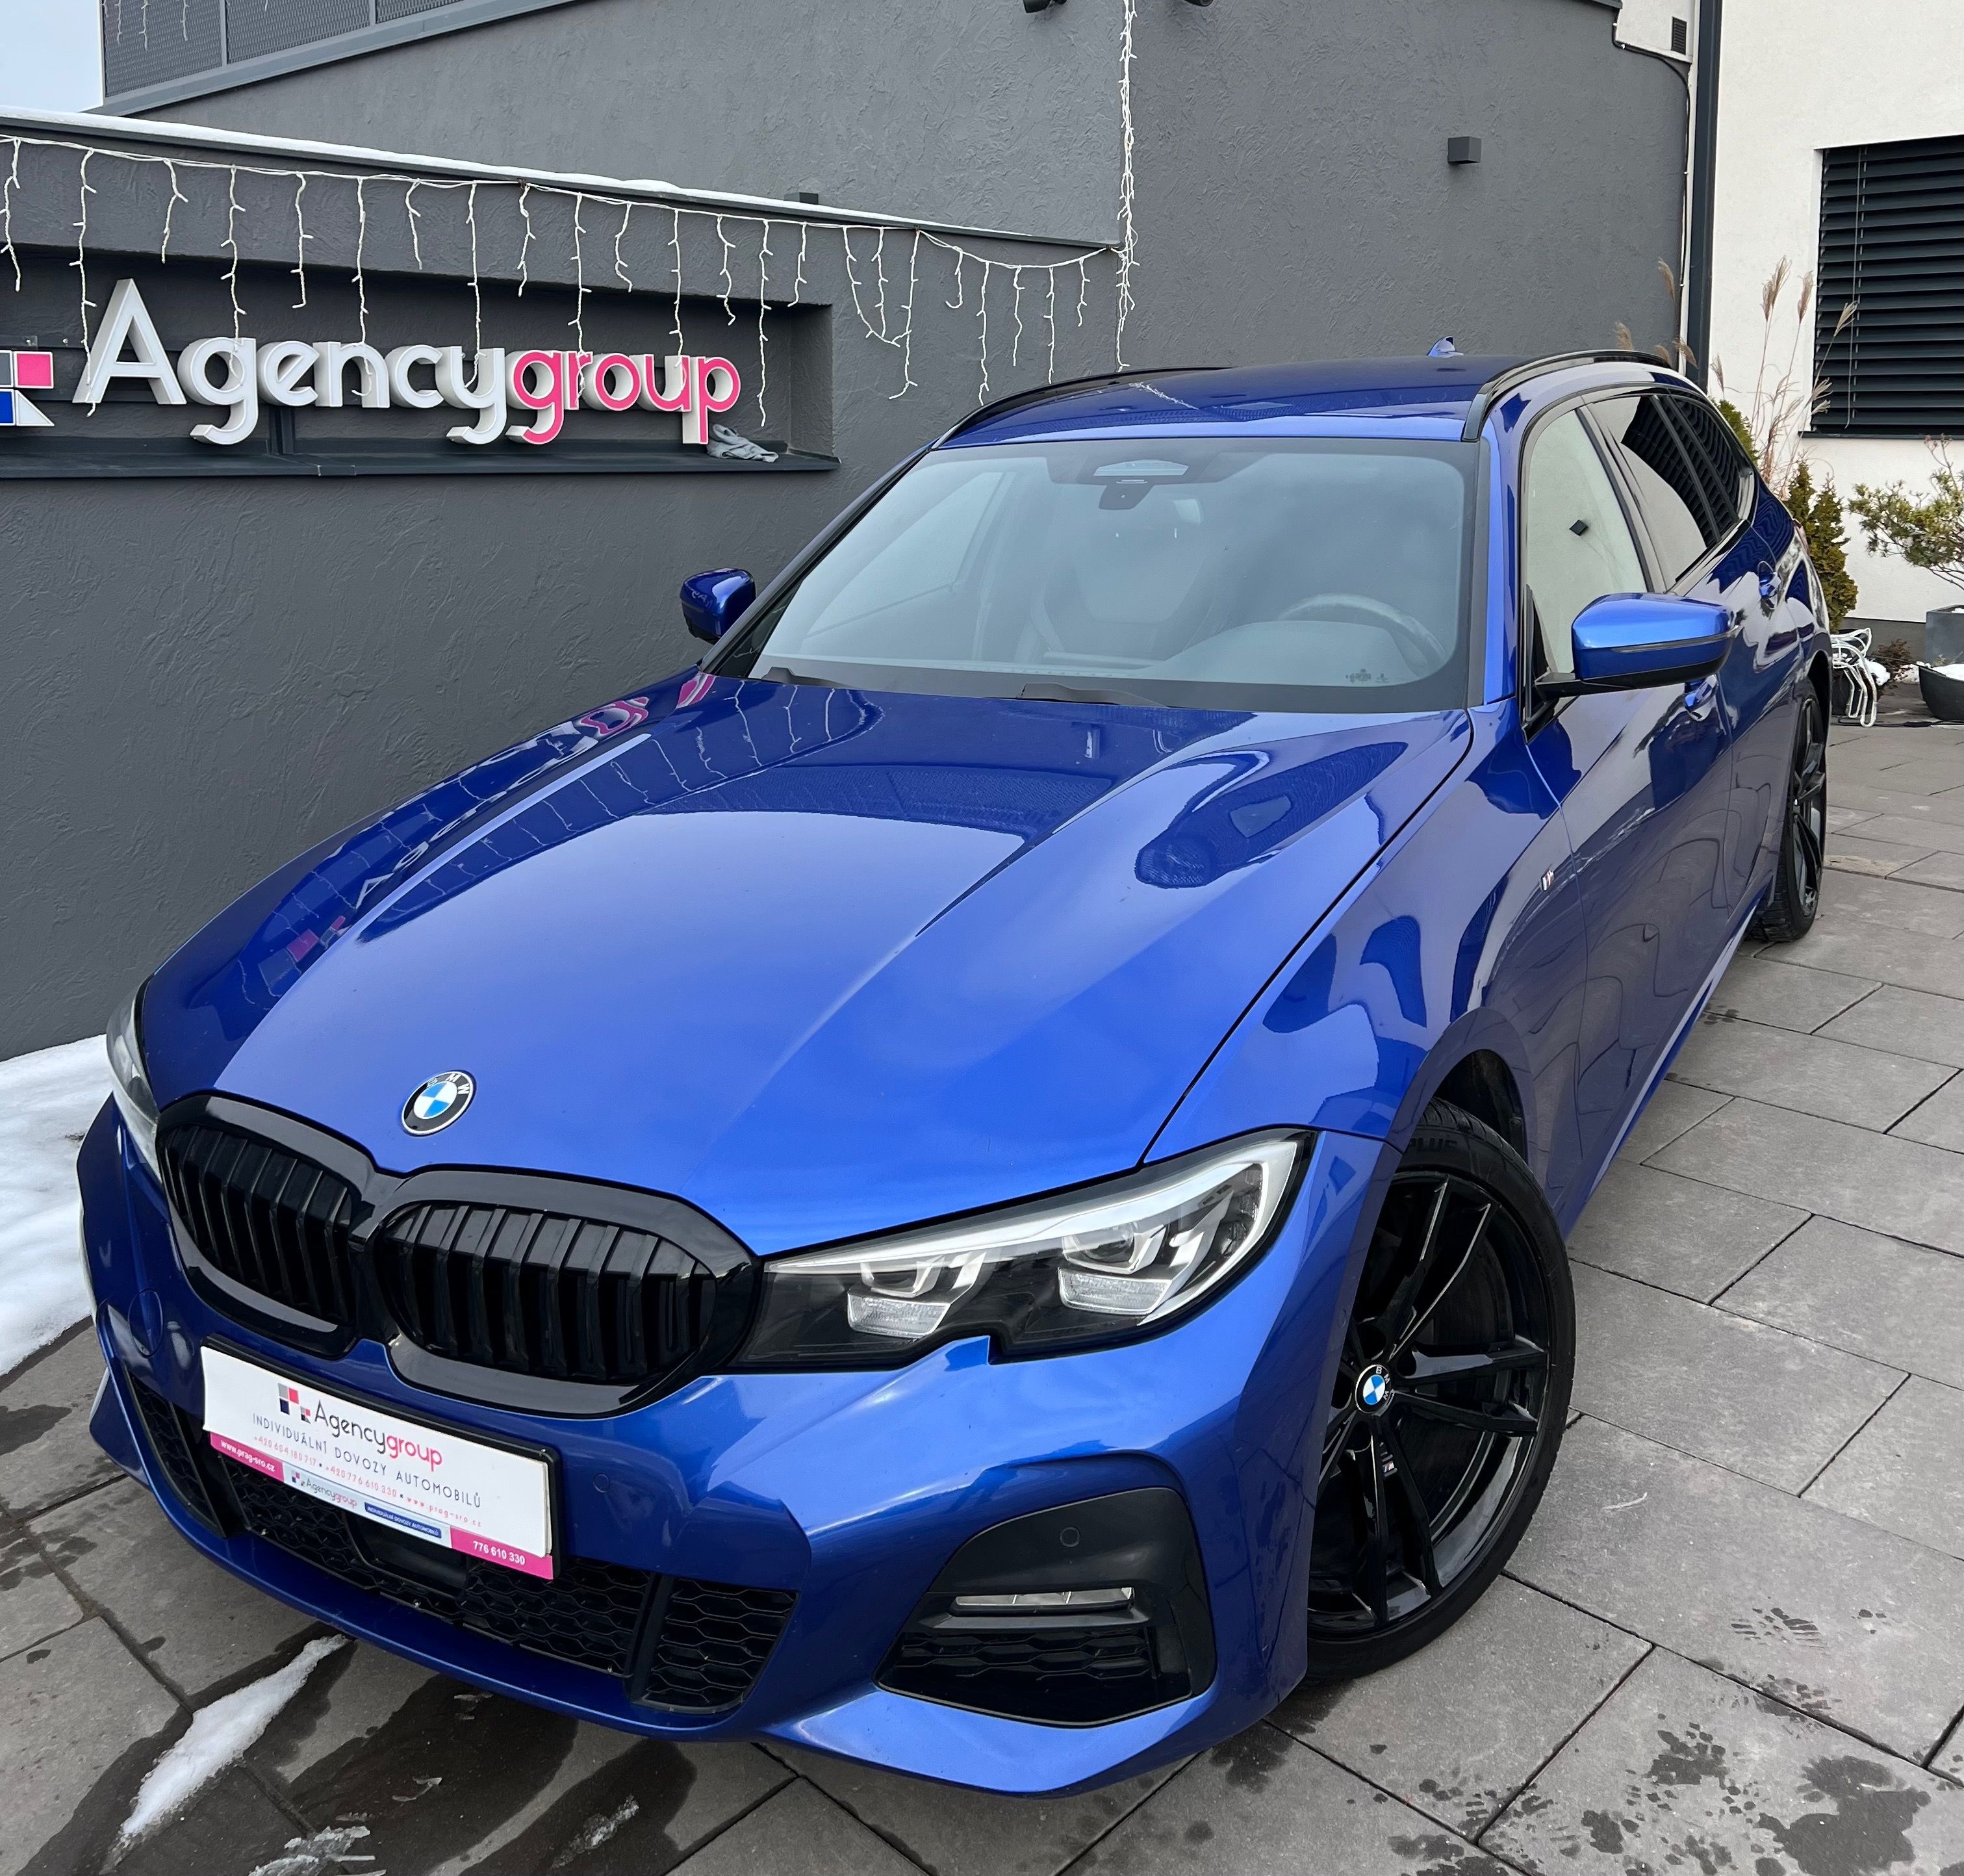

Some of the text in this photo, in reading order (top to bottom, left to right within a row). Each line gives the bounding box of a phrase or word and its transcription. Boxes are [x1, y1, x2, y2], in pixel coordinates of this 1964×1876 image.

[71, 278, 740, 445] Agencygroup
[426, 1072, 470, 1095] BMW
[1375, 1365, 1390, 1400] BMW
[253, 1413, 481, 1508] INDIVIDUÁLNÍ DOVOZY AUTOMOBILŮ
[314, 1400, 442, 1472] Agencygroup
[473, 1540, 526, 1565] 776 610 330
